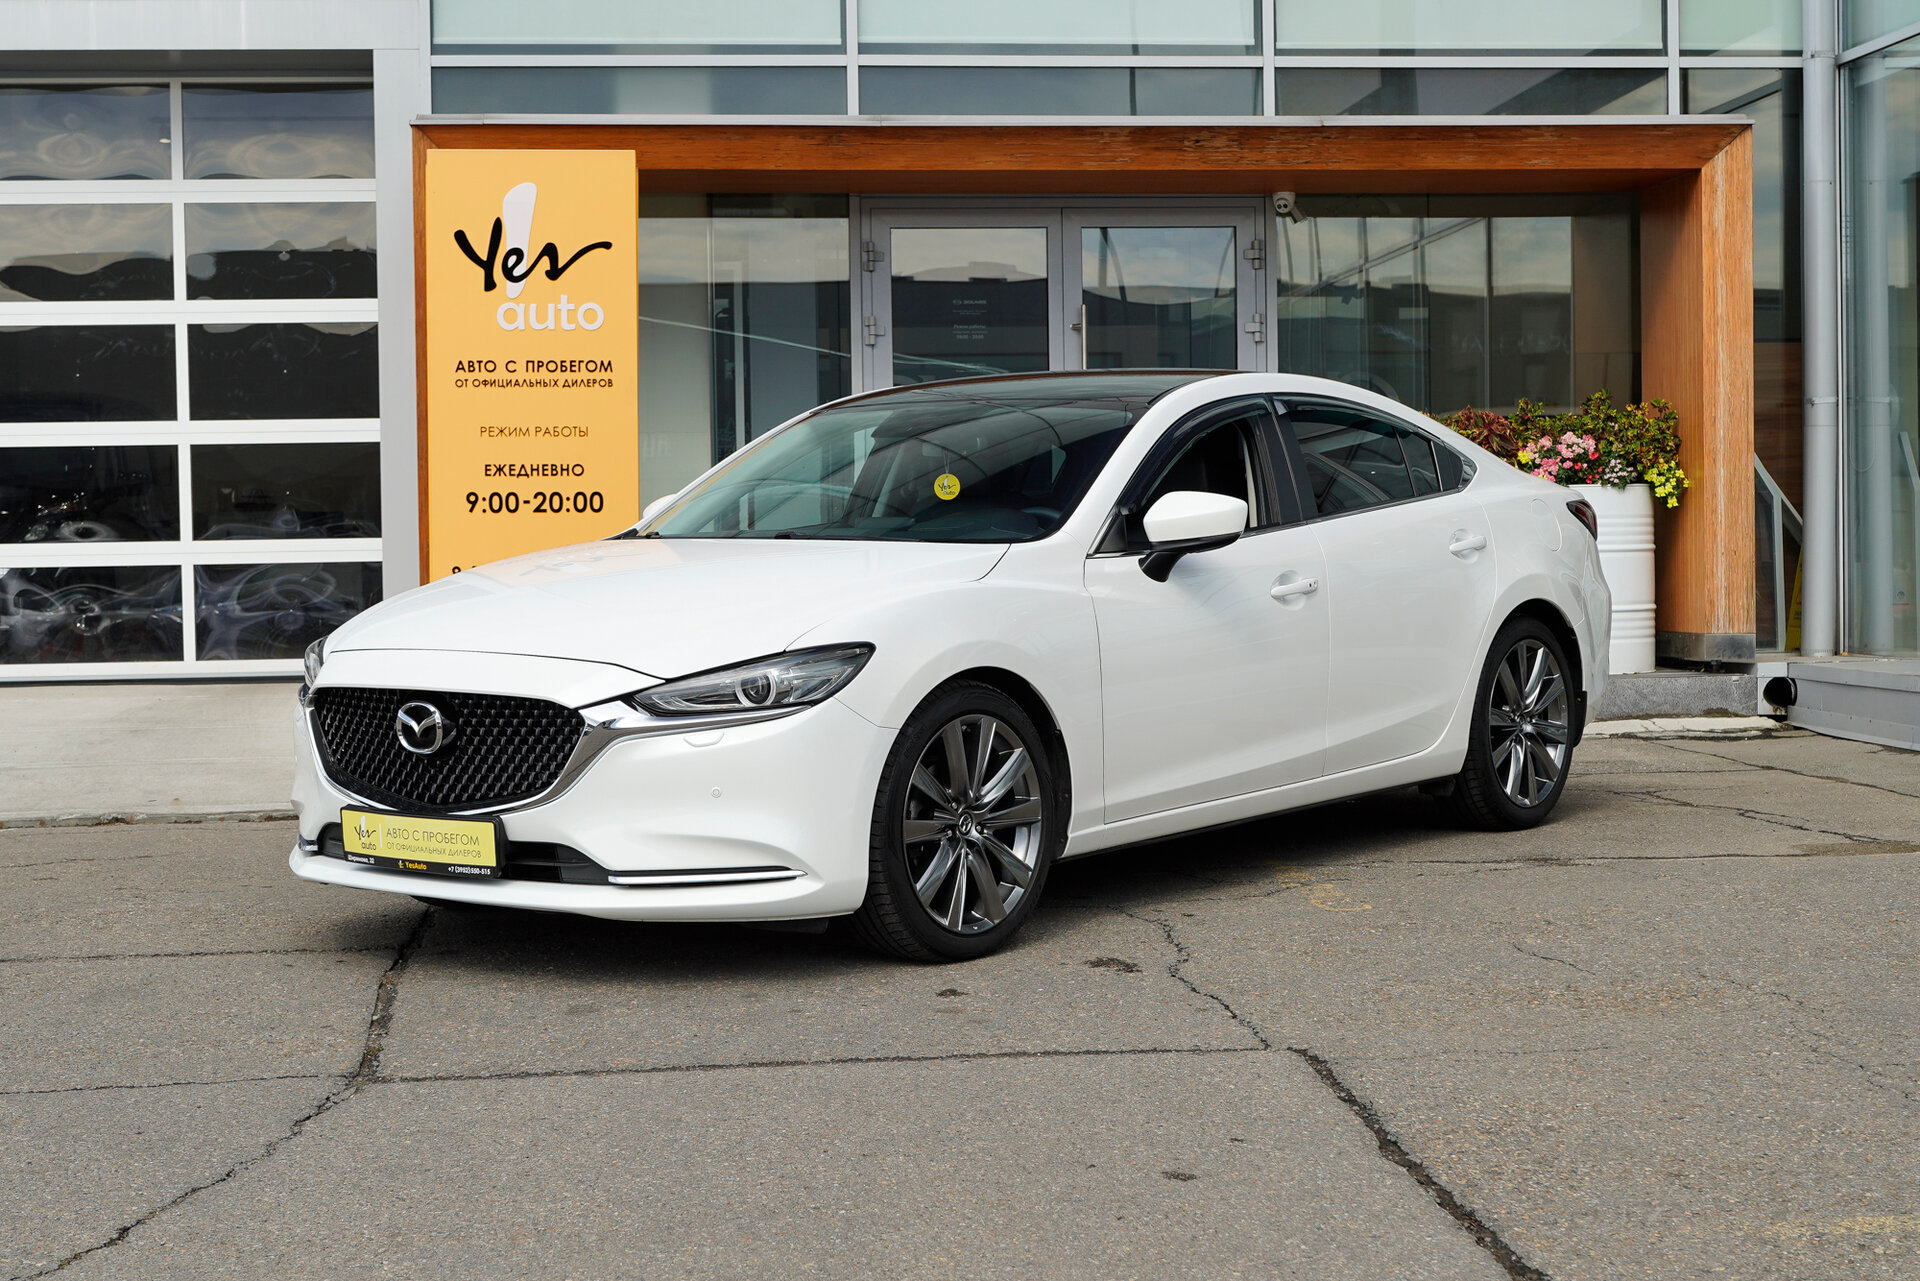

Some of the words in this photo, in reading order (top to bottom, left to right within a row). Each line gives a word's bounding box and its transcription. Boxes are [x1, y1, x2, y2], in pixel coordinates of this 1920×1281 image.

[496, 294, 605, 331] auto
[455, 359, 497, 374] АВТО
[505, 359, 517, 374] С
[525, 359, 613, 374] ПРОБЕГОМ
[455, 378, 469, 388] ОТ
[471, 378, 560, 389] ОФИЦИАЛЬНЫХ
[562, 378, 614, 389] ДИЛЕРОВ
[480, 425, 531, 438] РЕЖИМ
[534, 425, 589, 438] РАБОТЫ
[484, 463, 585, 478] ЕЖЕДНЕВНО
[466, 491, 604, 514] 9:00-20:00
[386, 827, 410, 841] АВТО
[412, 829, 421, 842] С
[422, 830, 480, 846] ПРОБЕГОМ
[361, 841, 377, 851] auto
[386, 841, 395, 850] ОТ
[396, 842, 447, 856] ОФИЦИАЛЬНЫХ
[447, 848, 482, 859] ДИЛЕРОВ
[405, 861, 428, 871] YesAuto
